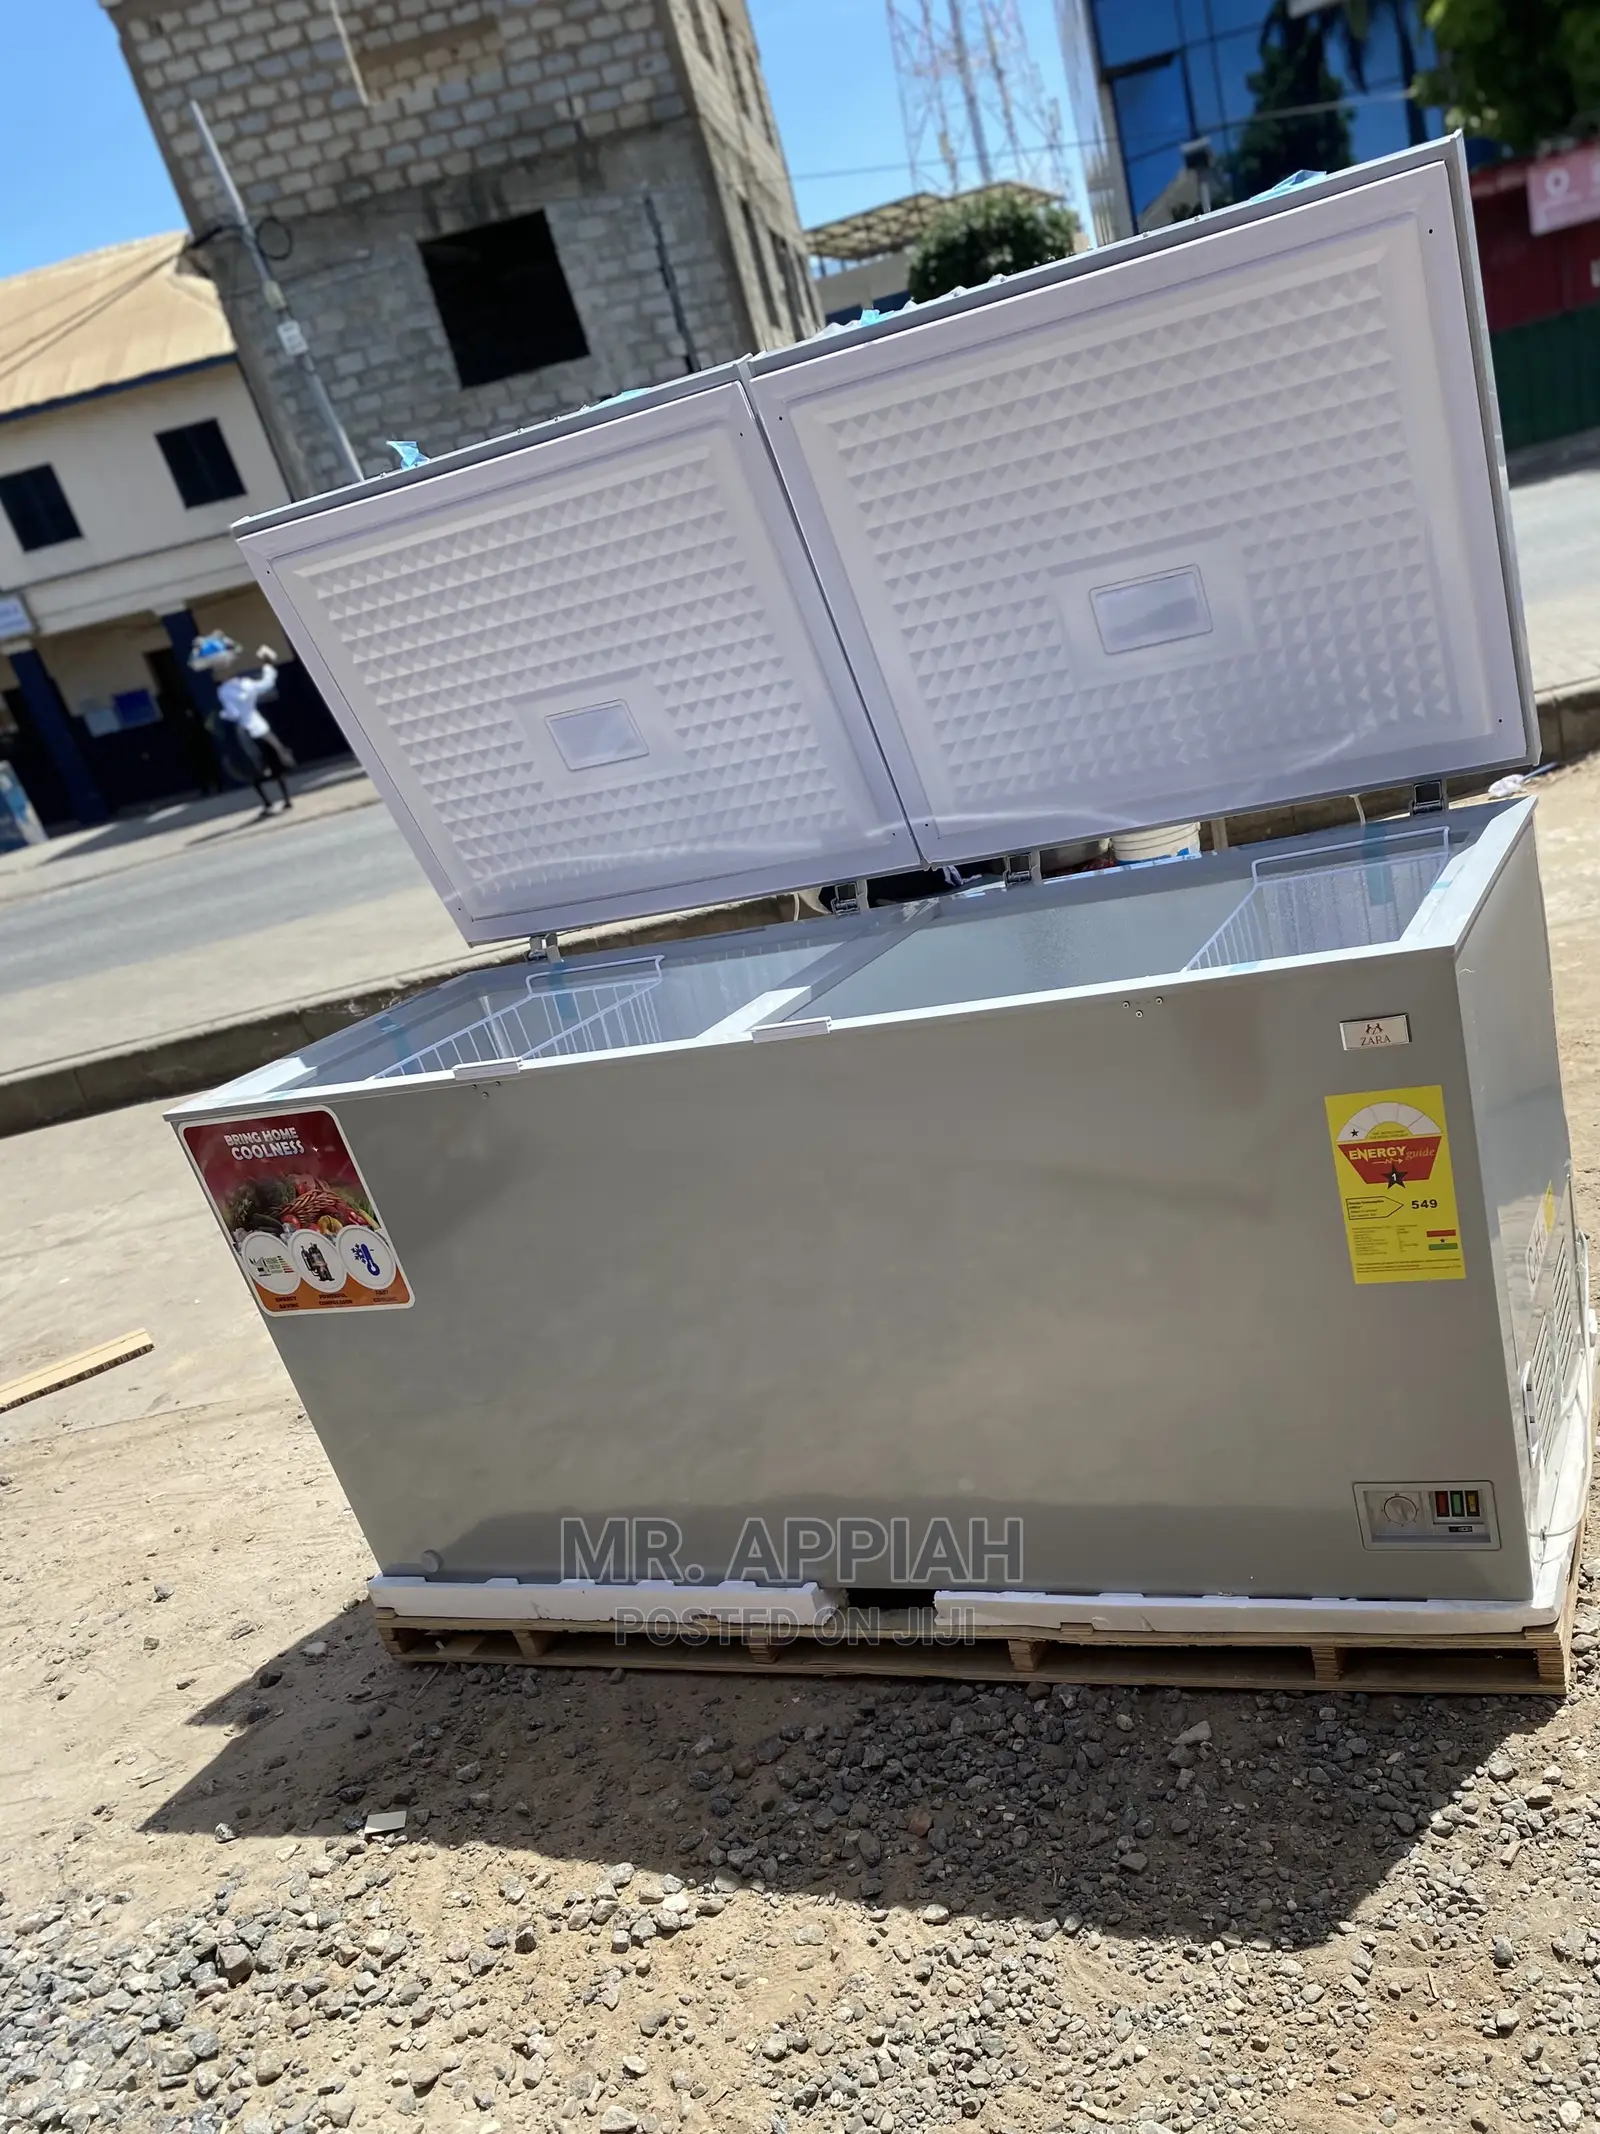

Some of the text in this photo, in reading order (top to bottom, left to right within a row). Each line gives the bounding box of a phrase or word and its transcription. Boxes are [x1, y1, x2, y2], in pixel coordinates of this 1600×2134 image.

[1360, 1035, 1391, 1046] ZARA
[223, 1127, 299, 1146] BRING HOME
[231, 1140, 305, 1160] COOLNESS
[1348, 1146, 1435, 1162] ENERGY guide
[1391, 1173, 1397, 1181] 1
[1411, 1199, 1438, 1209] 549
